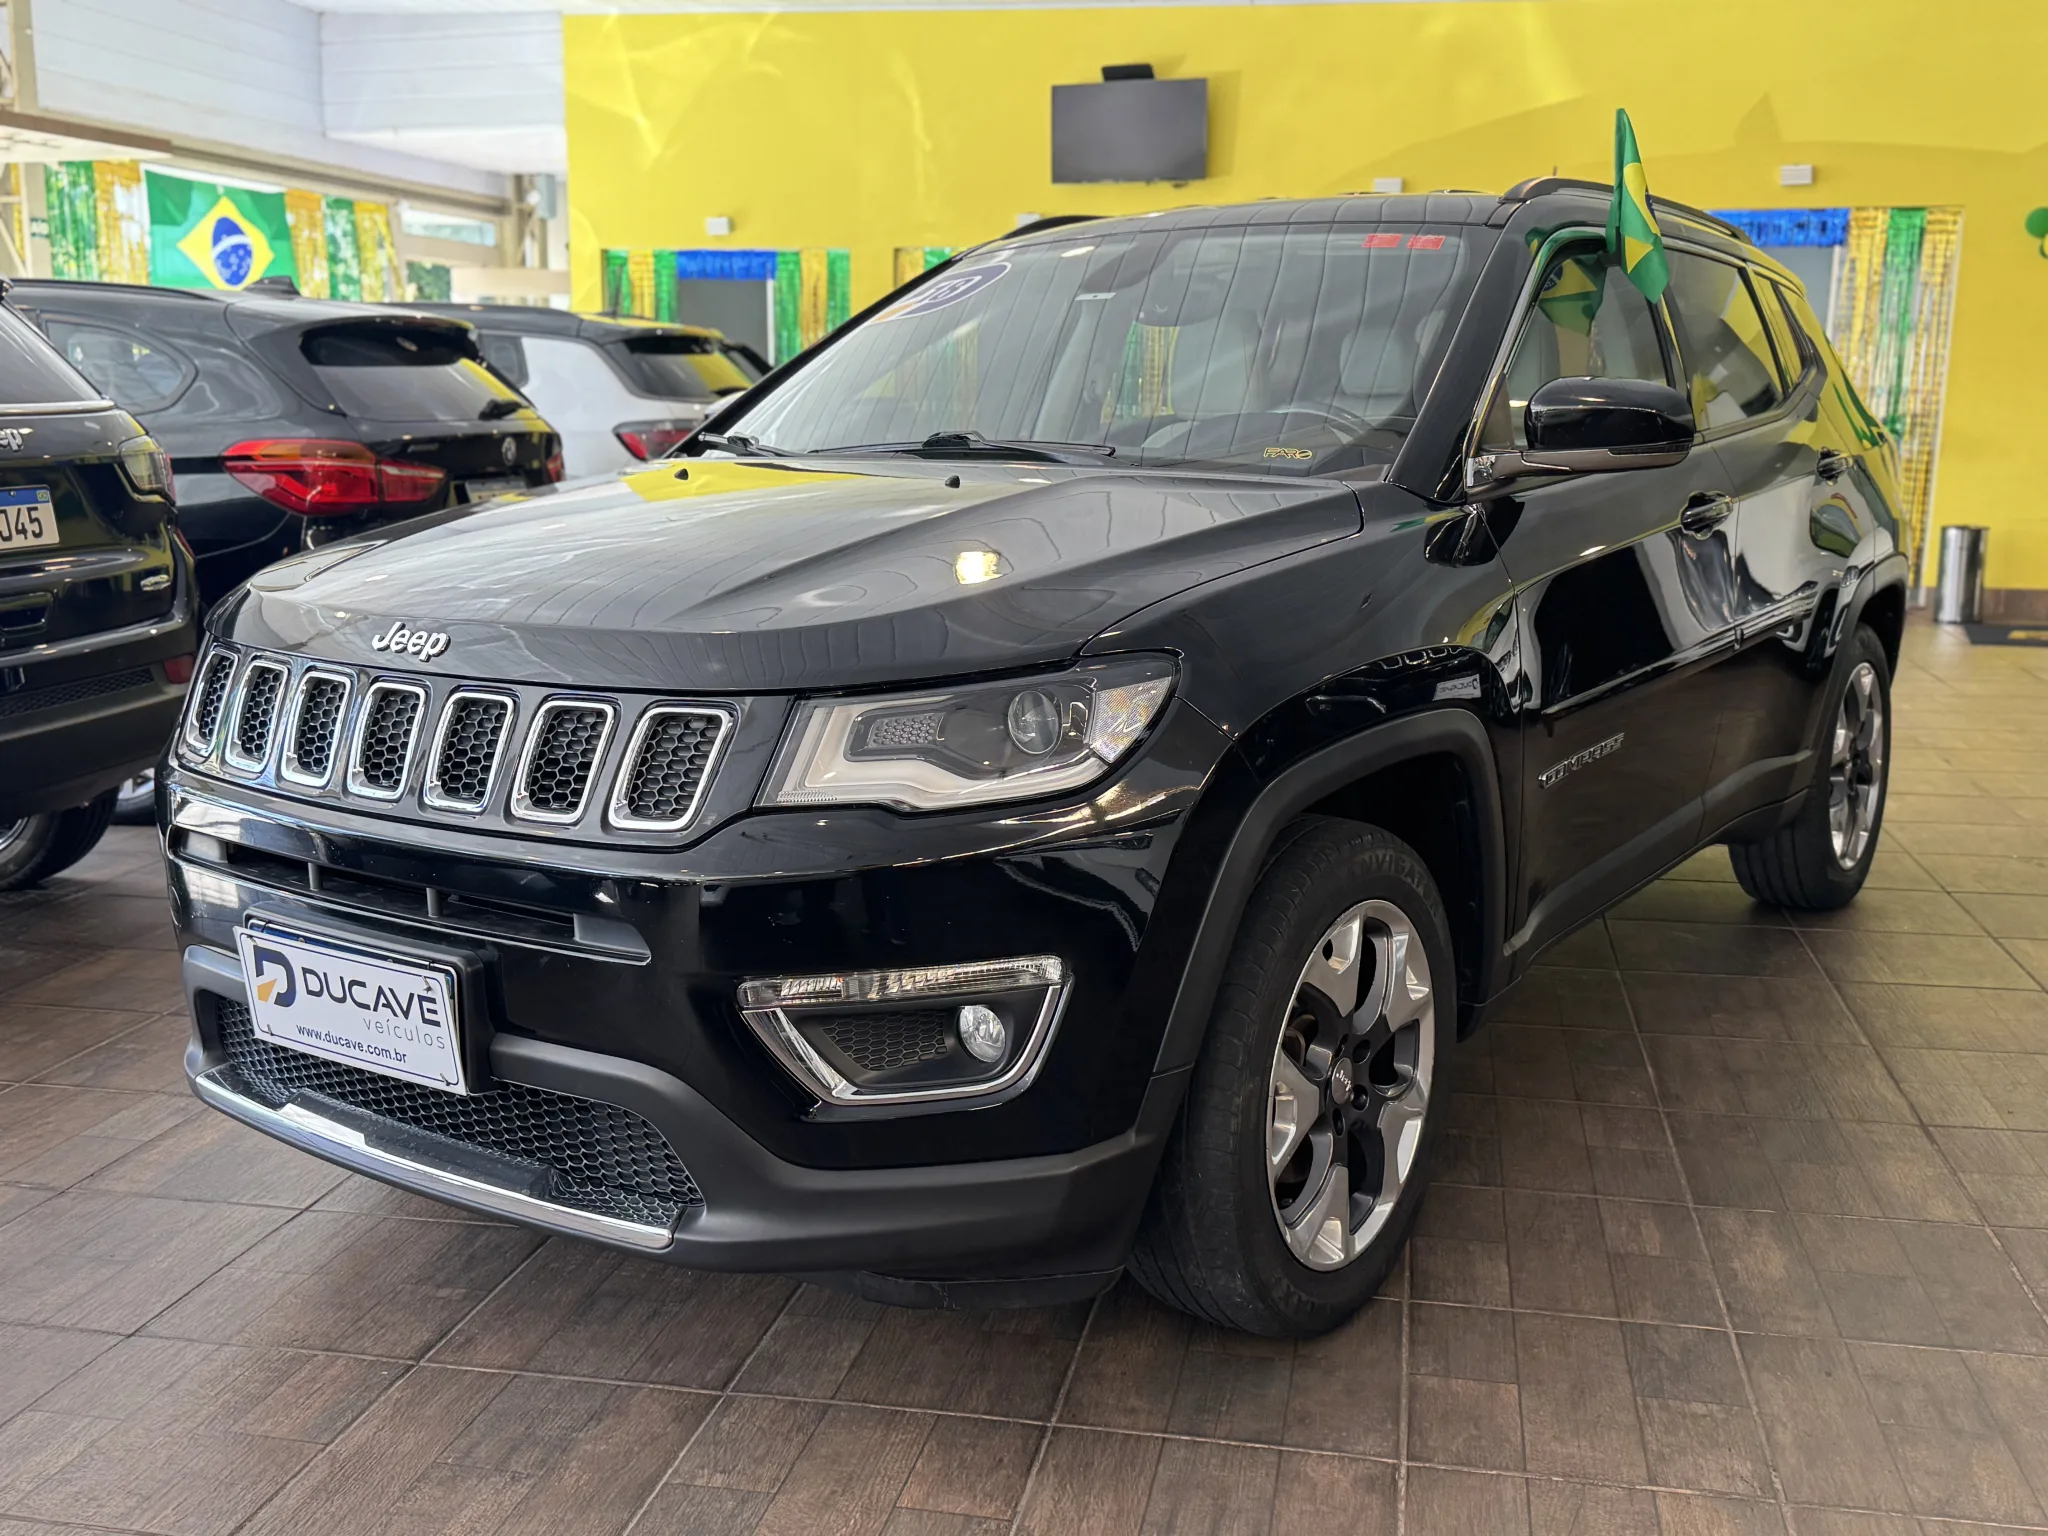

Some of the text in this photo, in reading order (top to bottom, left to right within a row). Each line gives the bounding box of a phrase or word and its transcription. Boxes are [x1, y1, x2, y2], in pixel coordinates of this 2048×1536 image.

[371, 621, 452, 663] Jeep
[295, 1022, 408, 1064] www.ducave.com.br
[362, 1015, 446, 1051] veículos
